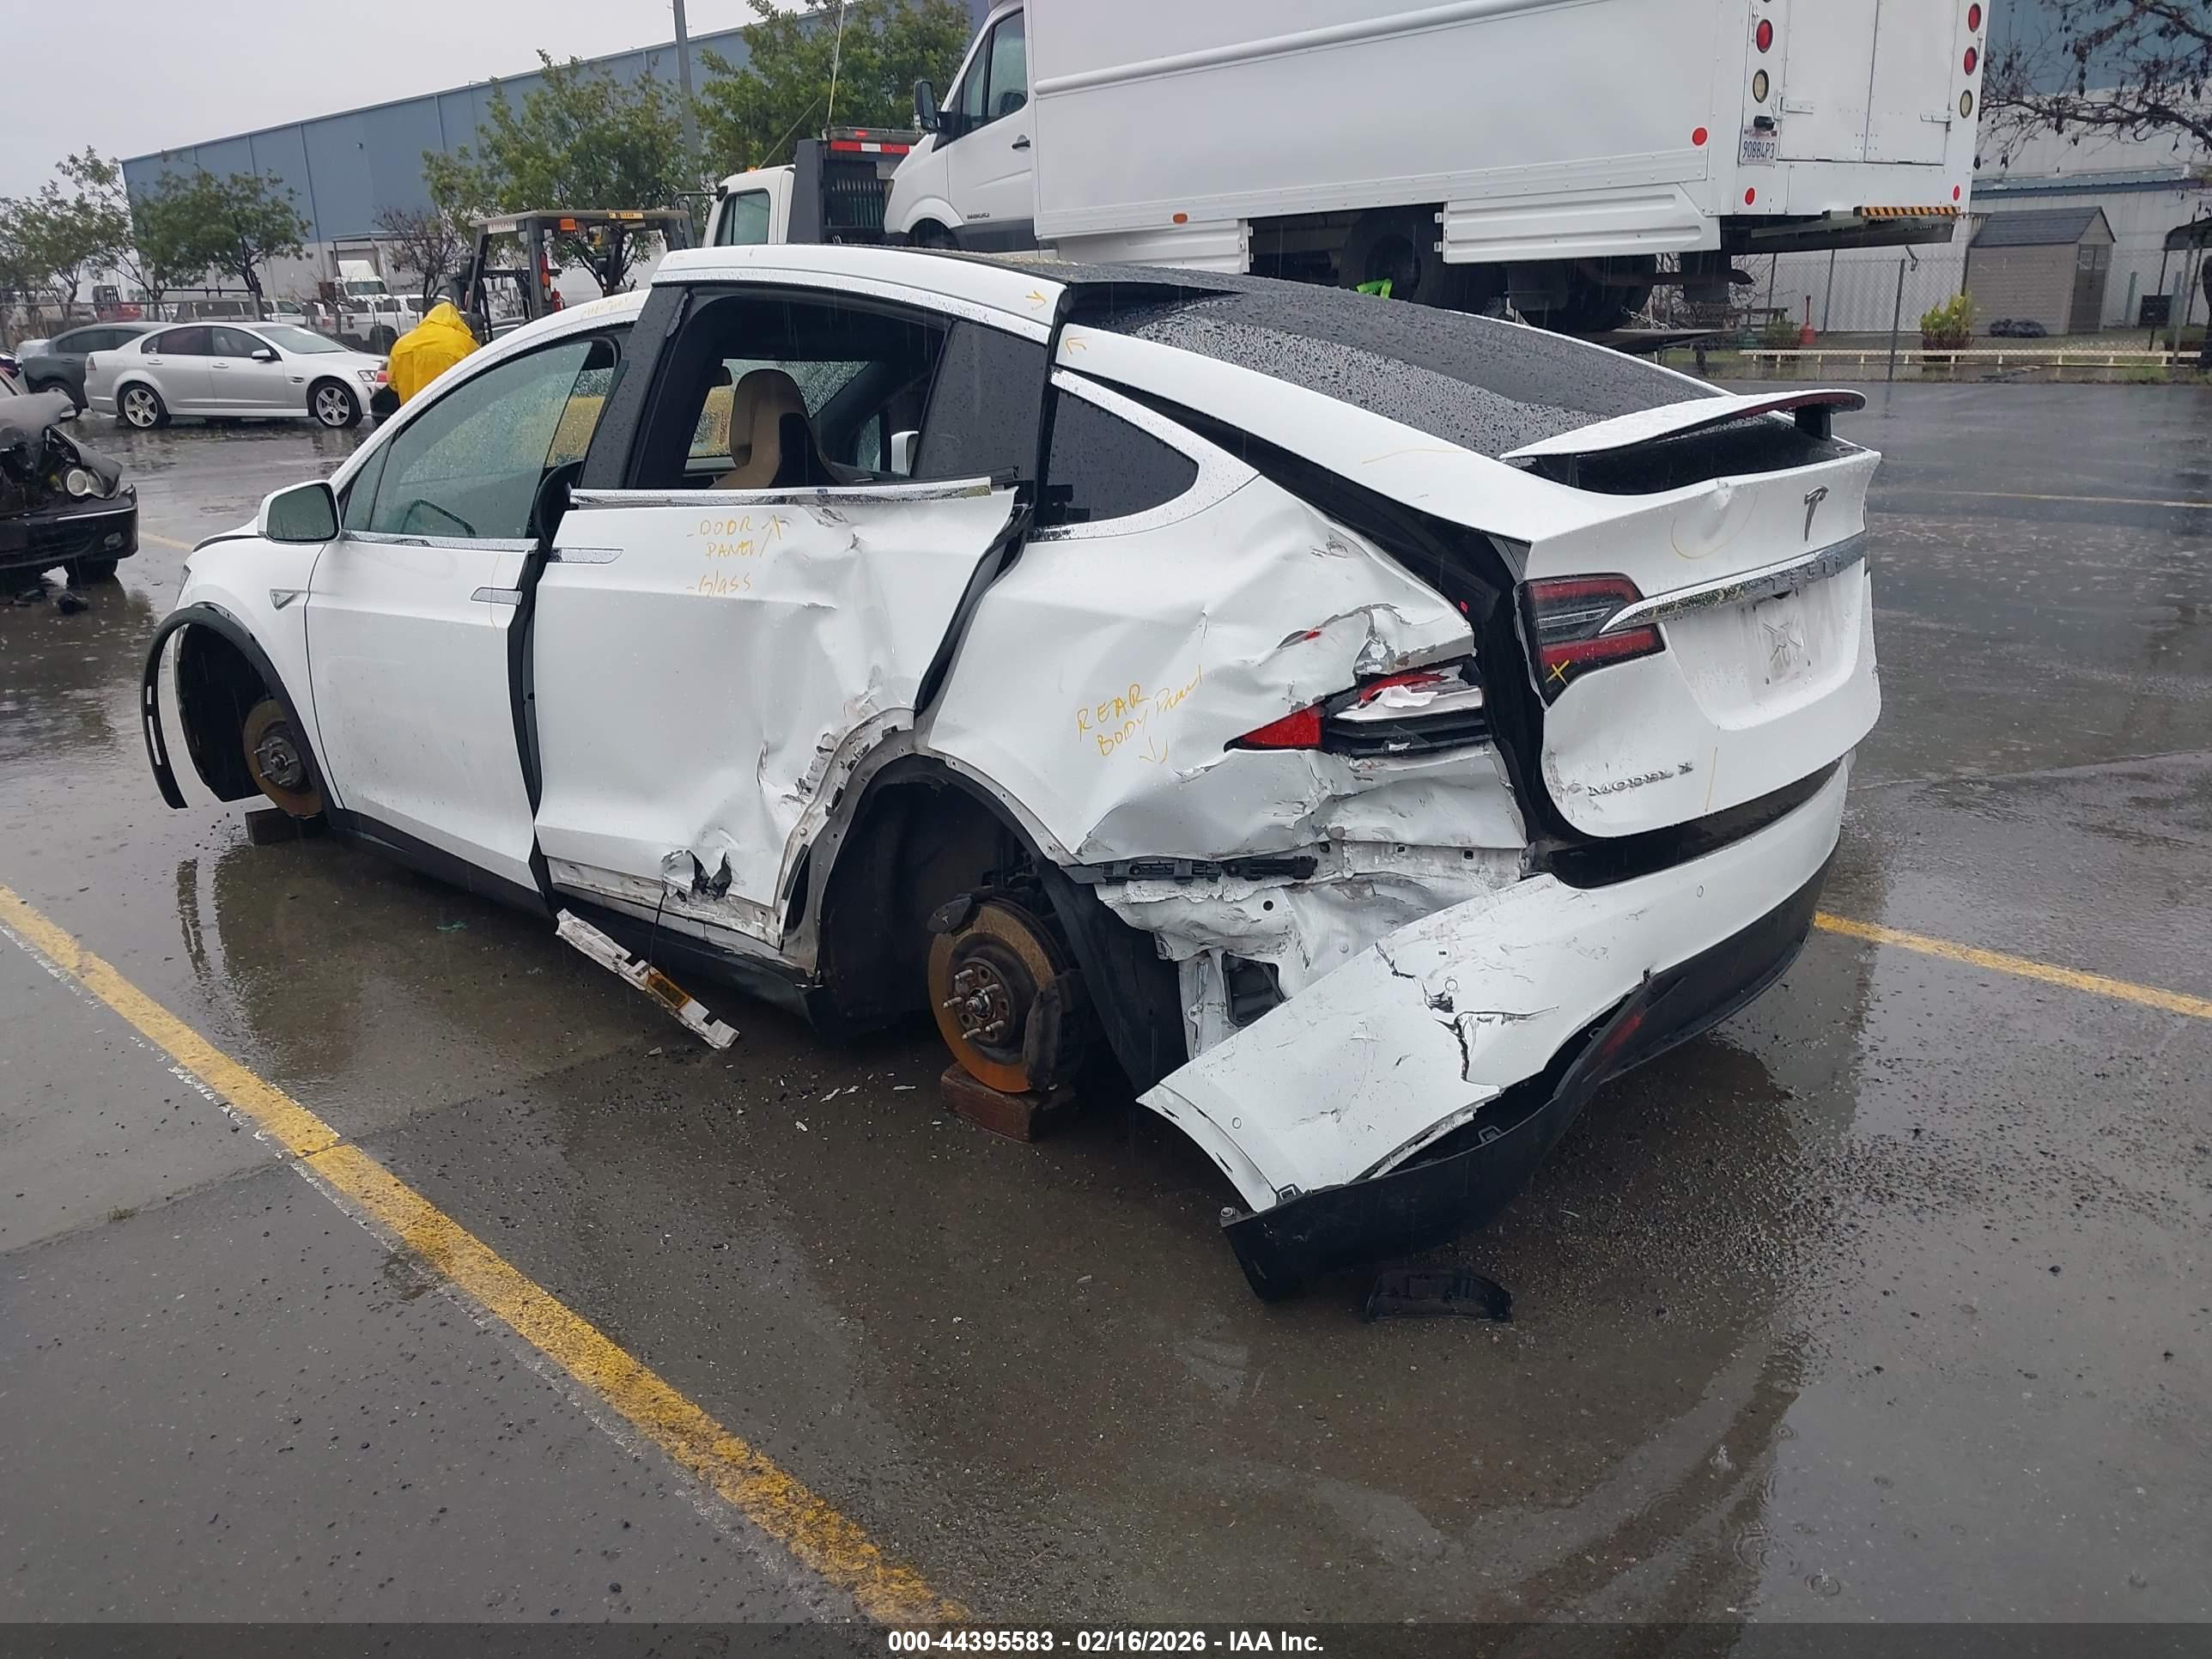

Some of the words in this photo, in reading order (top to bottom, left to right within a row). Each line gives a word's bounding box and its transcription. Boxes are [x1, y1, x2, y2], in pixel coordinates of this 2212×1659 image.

[1743, 141, 1775, 159] 90884P3
[700, 514, 754, 536] DOOR
[1077, 683, 1150, 742] REAR
[1097, 708, 1148, 757] BODY
[1588, 770, 1674, 797] MODEL
